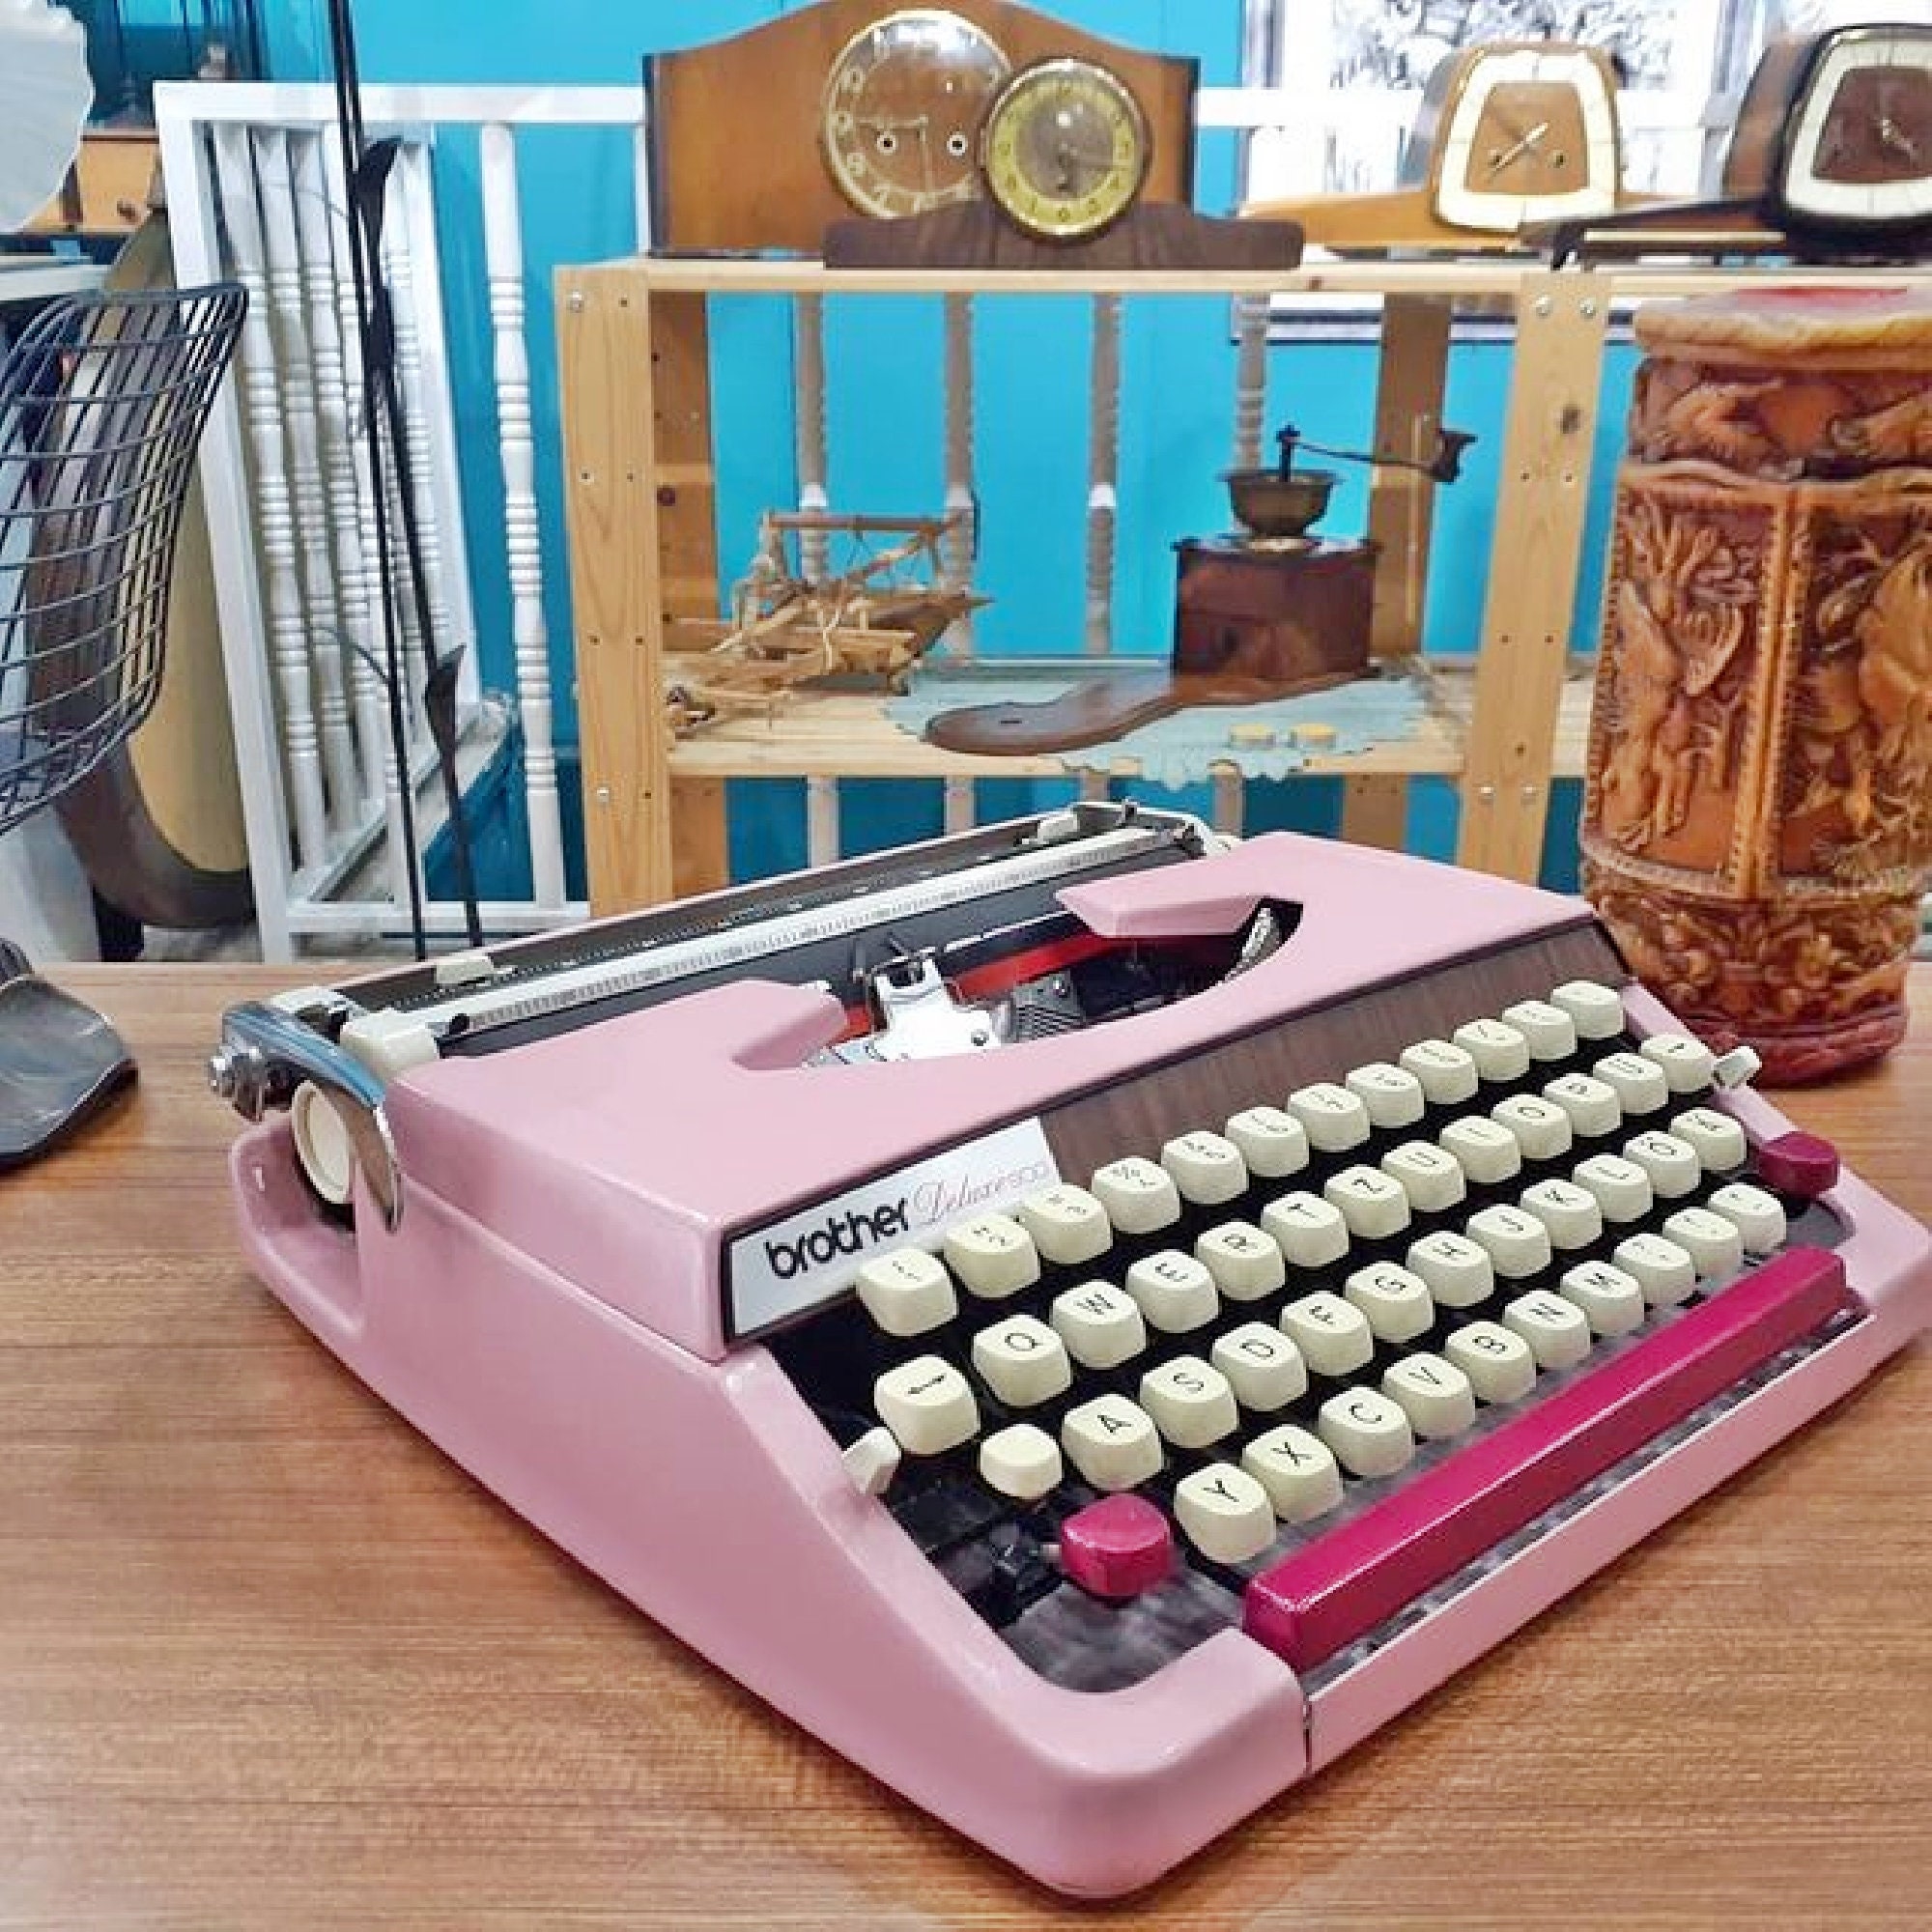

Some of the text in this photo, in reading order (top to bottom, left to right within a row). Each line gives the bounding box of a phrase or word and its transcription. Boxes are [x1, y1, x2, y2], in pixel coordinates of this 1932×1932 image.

[763, 1197, 909, 1280] brother
[1005, 1332, 1044, 1351] Q
[1154, 1263, 1189, 1282] E
[1096, 1414, 1132, 1434] A
[1173, 1372, 1206, 1392] S
[1238, 1339, 1274, 1356] D
[1375, 1275, 1406, 1292] G
[1203, 1478, 1240, 1503] Y
[1269, 1441, 1312, 1466] X
[1349, 1402, 1382, 1424] C
[1407, 1366, 1441, 1385] V
[1471, 1335, 1508, 1354] B
